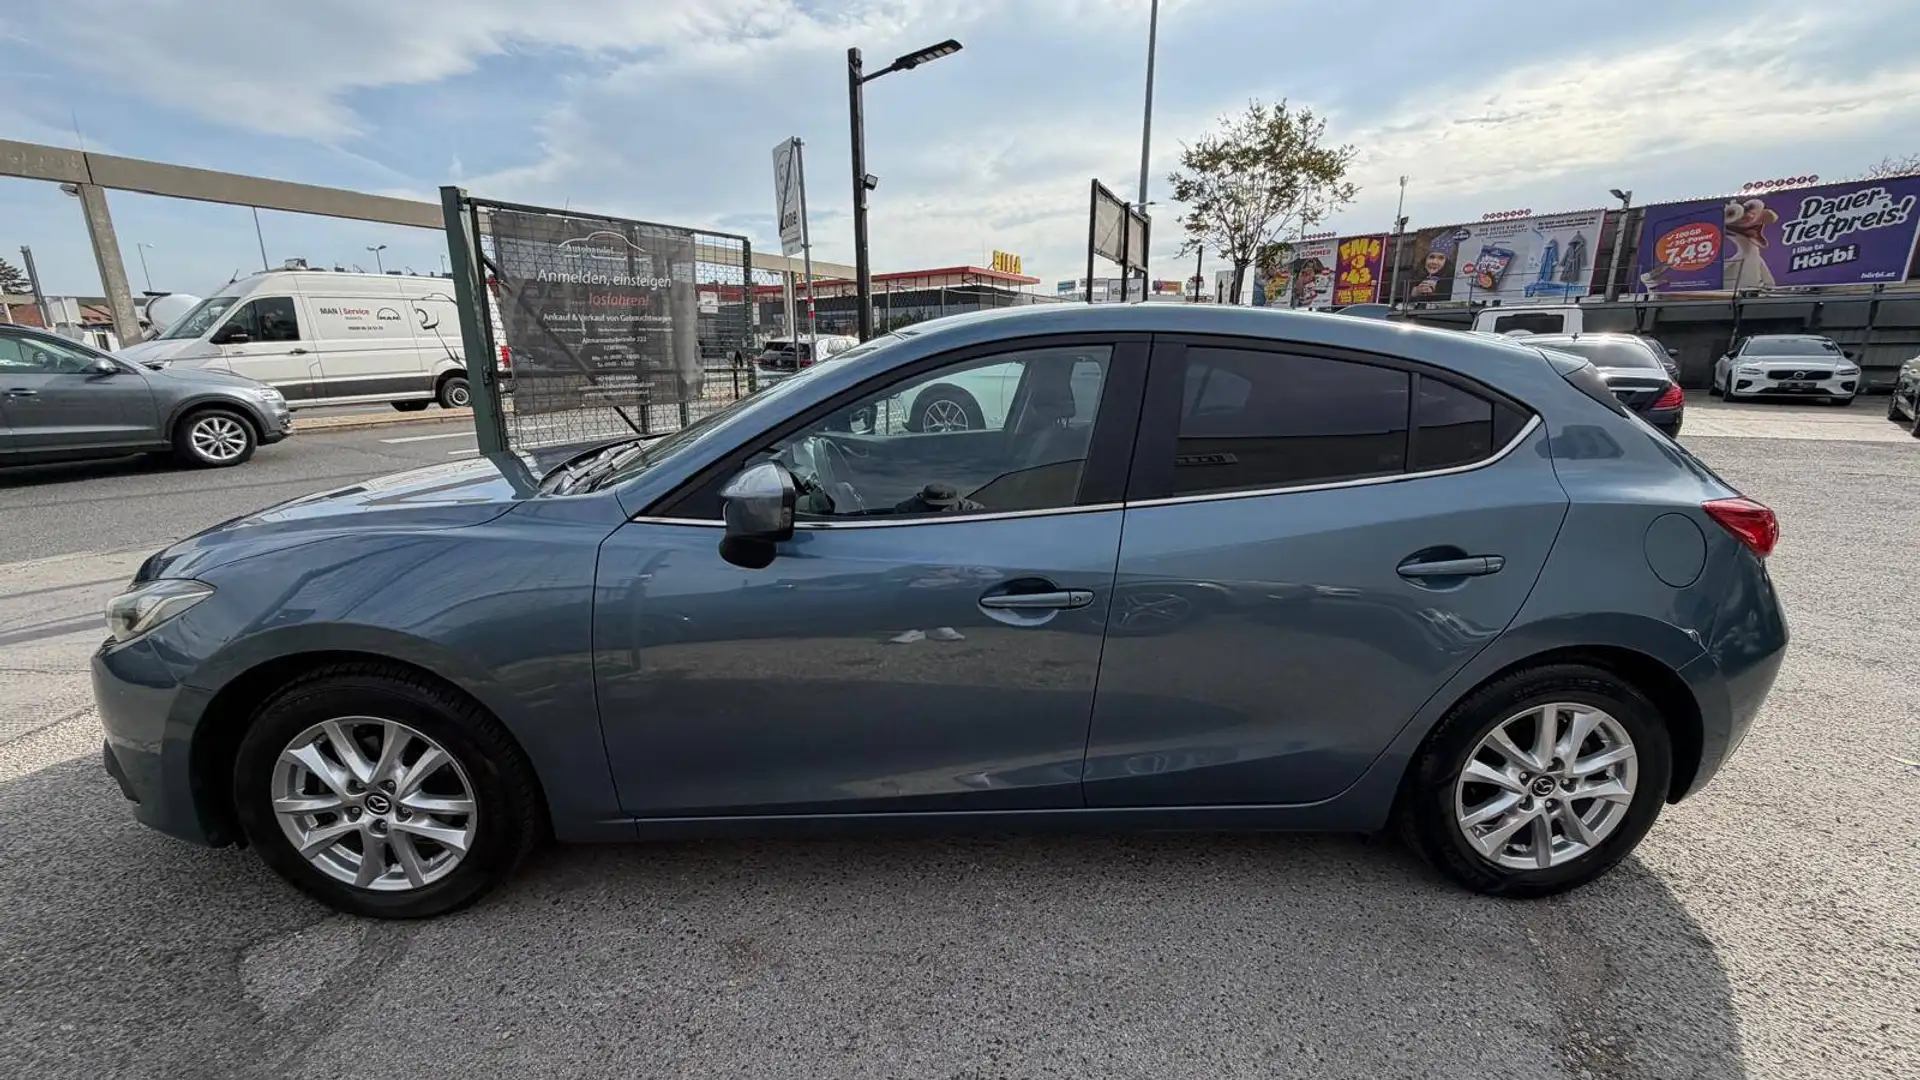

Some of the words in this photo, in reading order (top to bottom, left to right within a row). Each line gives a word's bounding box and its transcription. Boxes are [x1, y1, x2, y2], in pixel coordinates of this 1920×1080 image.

[1800, 187, 1890, 219] Dauer-
[1782, 197, 1914, 243] Tiefpreis!
[992, 249, 1022, 274] BILLA
[1792, 245, 1856, 270] Hörbi
[537, 269, 611, 286] Anmelden,
[612, 273, 672, 291] einsteigen
[589, 292, 650, 307] losfahren!
[319, 307, 338, 315] MAN
[342, 307, 370, 316] Service
[543, 313, 571, 321] Ankauf
